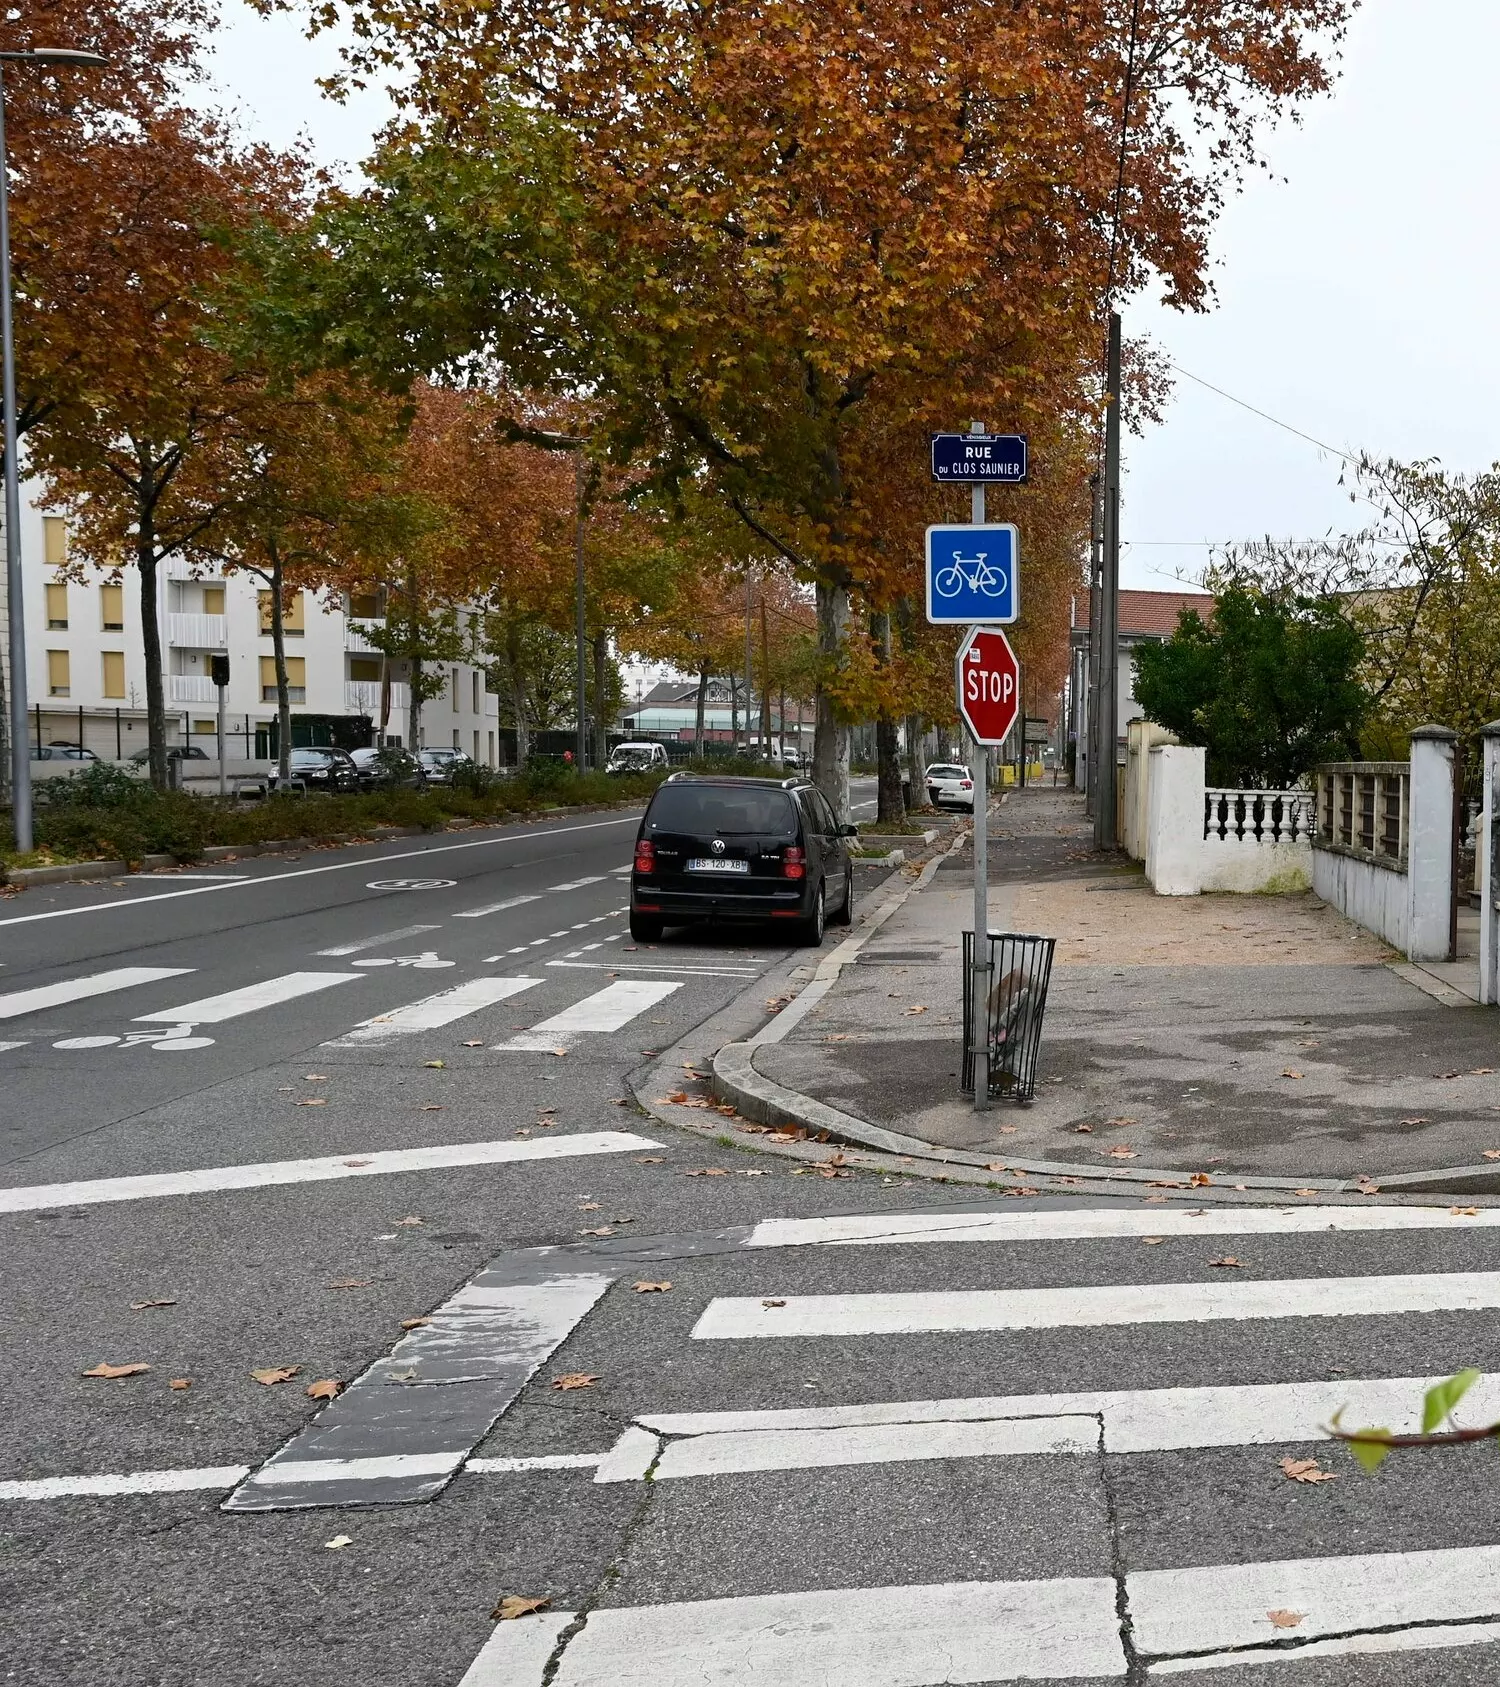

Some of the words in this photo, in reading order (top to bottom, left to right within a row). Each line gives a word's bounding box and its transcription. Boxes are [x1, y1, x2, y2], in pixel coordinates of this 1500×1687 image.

[965, 446, 992, 459] RUE
[938, 466, 948, 474] DU
[952, 462, 976, 474] CLOS
[980, 463, 1020, 475] SAUNIER
[967, 669, 1013, 704] STOP
